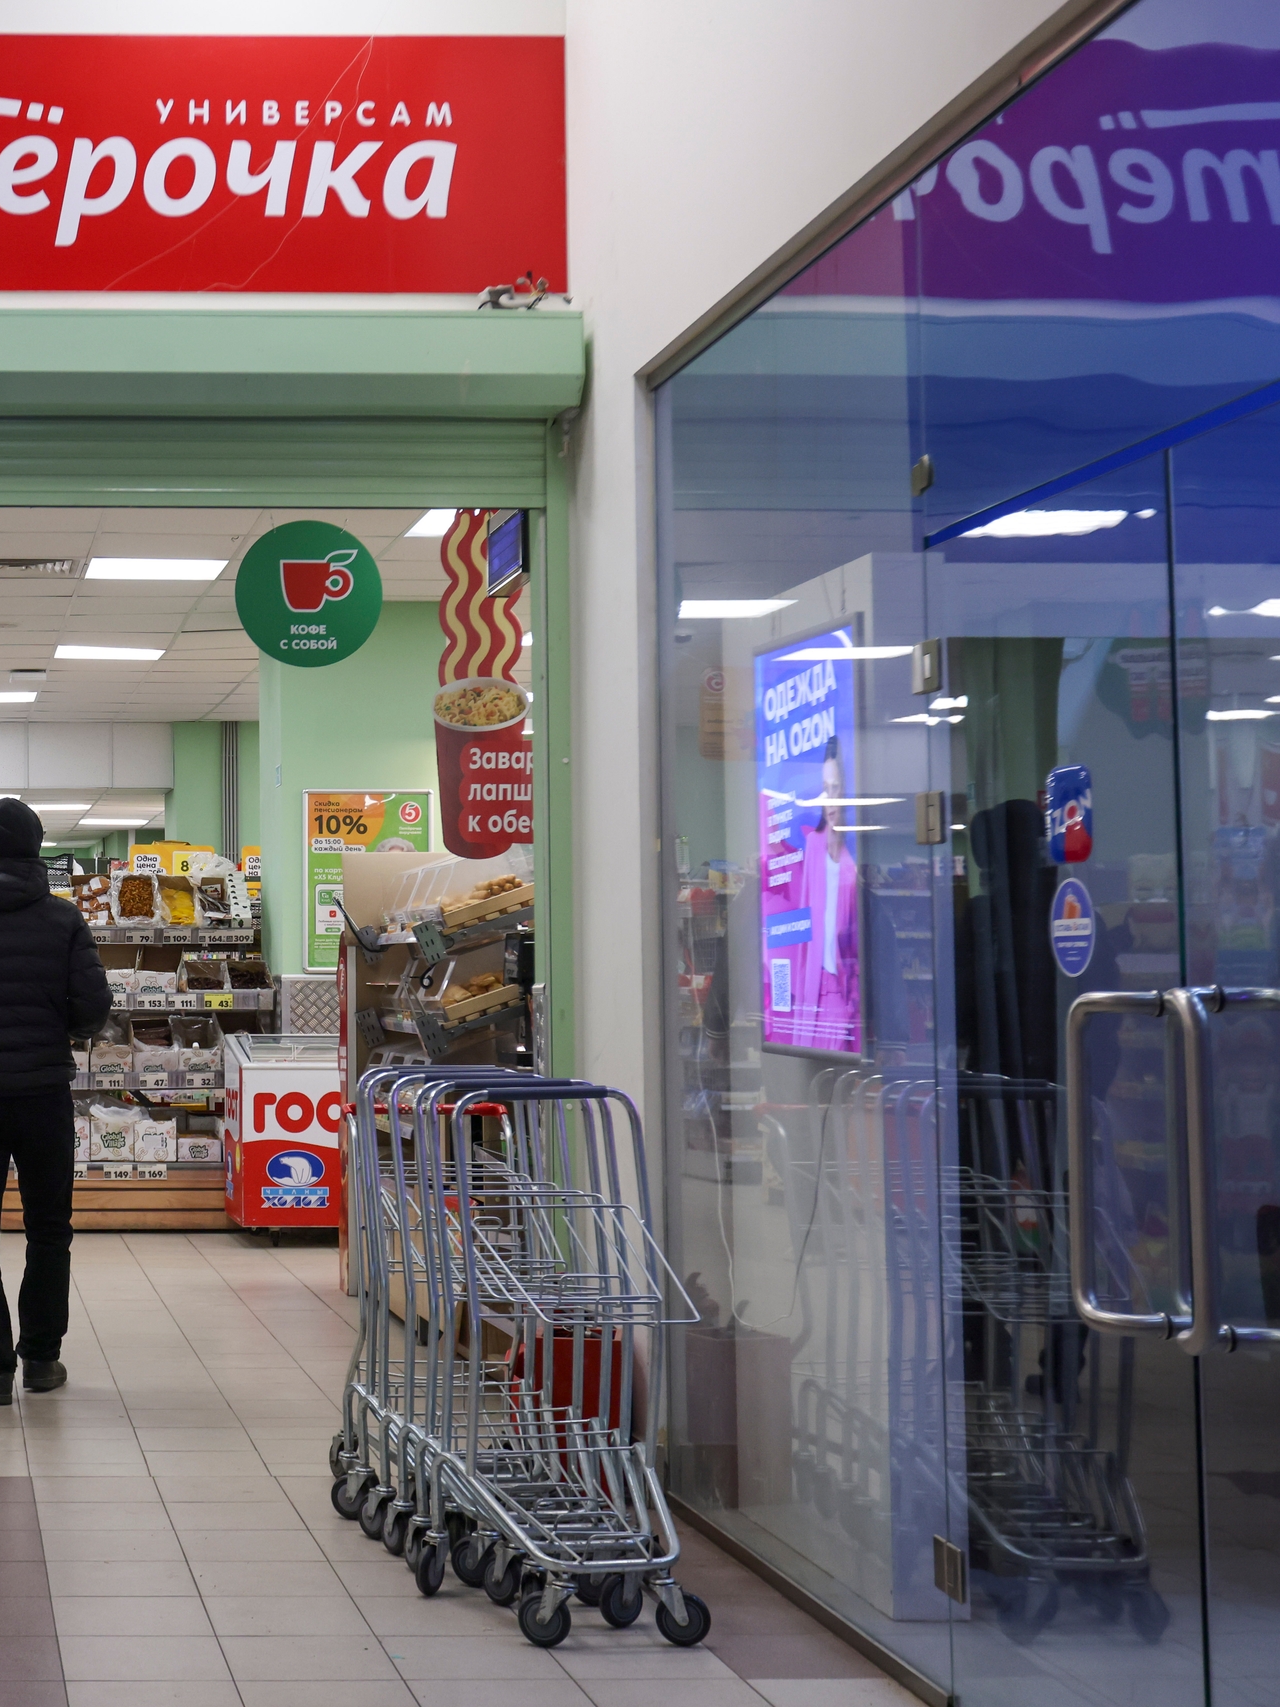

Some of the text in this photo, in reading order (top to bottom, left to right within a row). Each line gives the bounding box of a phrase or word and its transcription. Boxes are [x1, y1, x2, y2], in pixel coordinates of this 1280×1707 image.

[156, 98, 453, 127] УНИВЕРСАМ
[290, 624, 327, 635] КОФЕ
[279, 637, 337, 650] С СОБОЙ
[764, 659, 837, 724] ОДЕЖДА
[764, 706, 836, 768] НА OZON
[314, 814, 368, 835] 10%
[468, 809, 534, 833] к обе
[148, 1000, 162, 1008] 153
[181, 1000, 192, 1008] 111
[218, 1000, 229, 1008] 43
[100, 1064, 124, 1073] Global
[108, 1079, 120, 1087] 111
[101, 1132, 122, 1141] Global
[103, 1138, 126, 1149] Village
[261, 1195, 330, 1208] ХОЛОД
